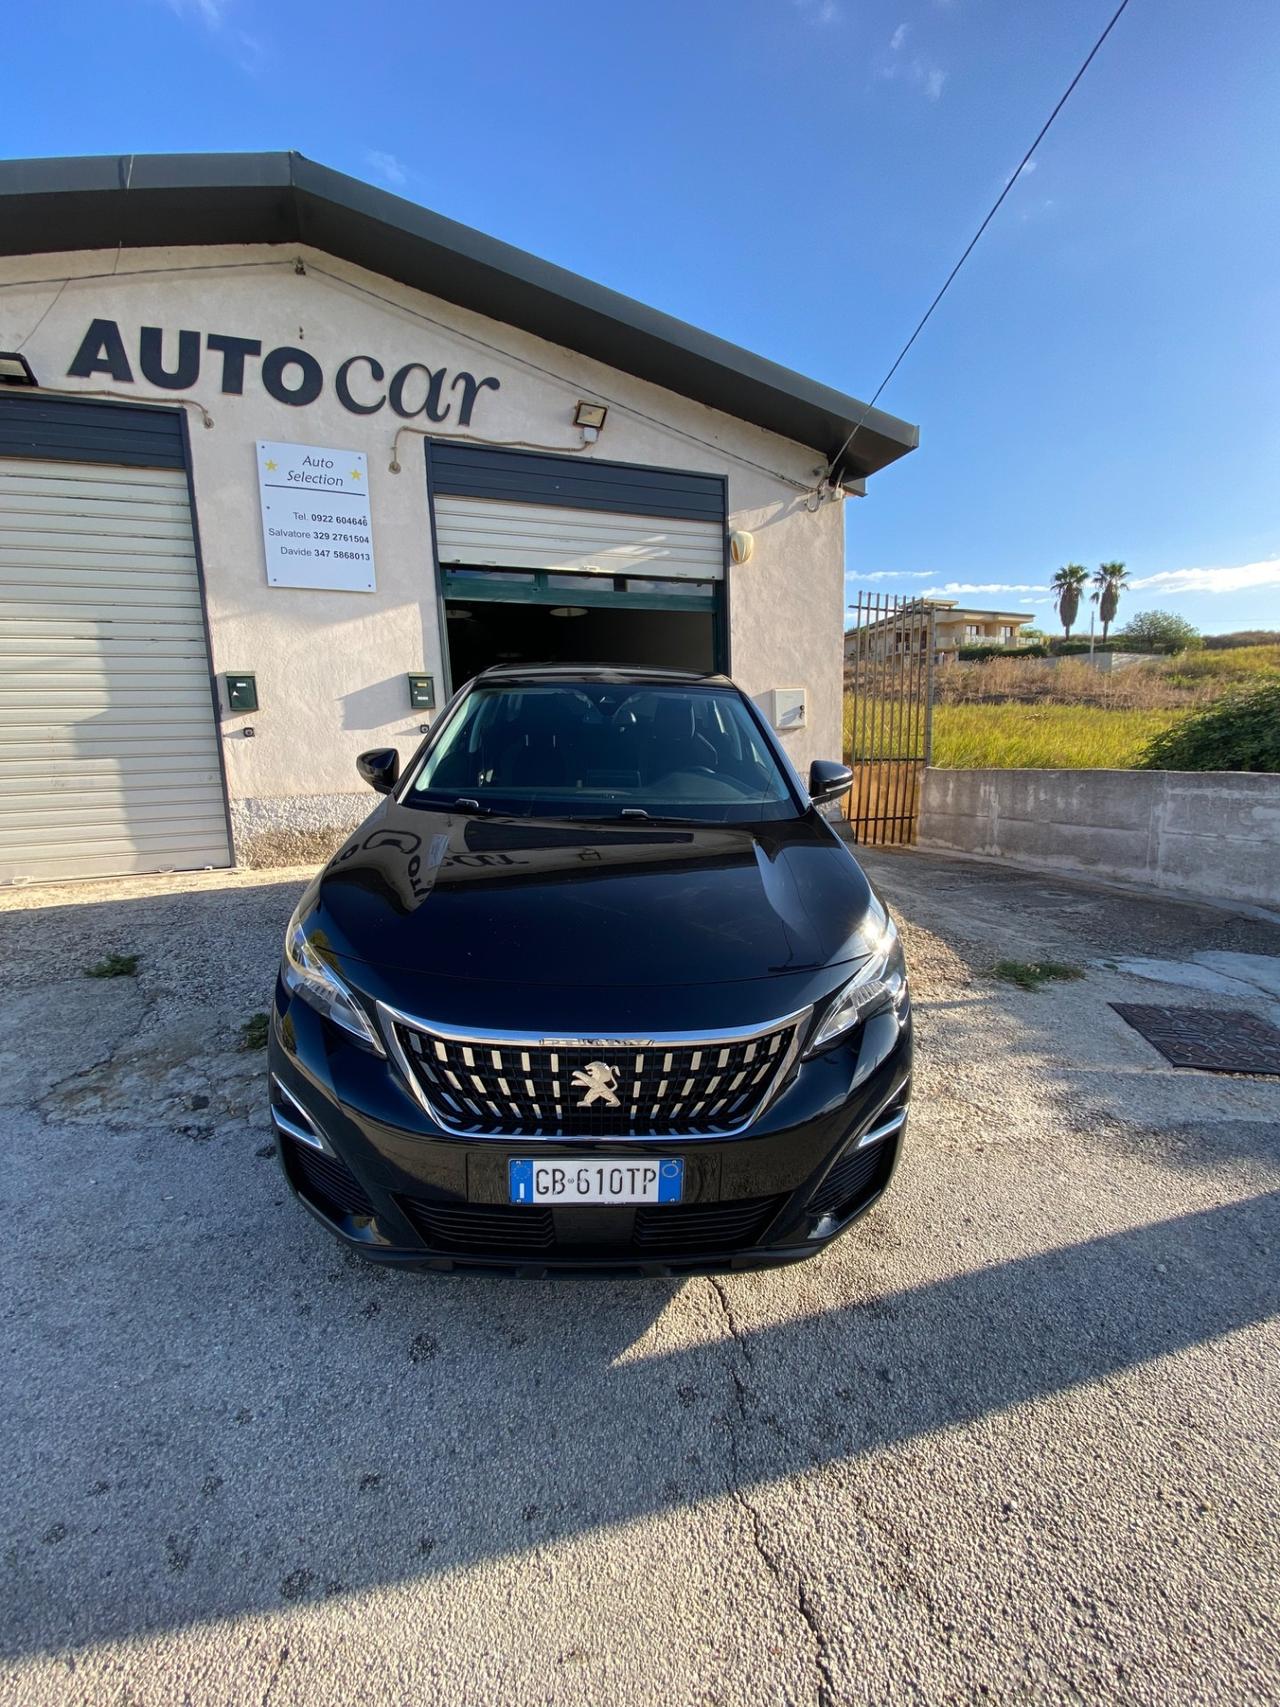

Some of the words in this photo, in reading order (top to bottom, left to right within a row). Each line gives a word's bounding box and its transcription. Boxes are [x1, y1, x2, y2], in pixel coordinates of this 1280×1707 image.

[302, 455, 334, 469] Auto
[287, 470, 344, 487] Selection
[293, 512, 308, 521] Tel.
[311, 513, 333, 523] 0922
[336, 516, 368, 526] 604646
[268, 528, 311, 538] Salvatore
[313, 532, 330, 540] 329
[333, 533, 369, 543] 2761504
[280, 546, 312, 557] Davide
[314, 549, 330, 557] 347
[333, 551, 370, 561] 5868013
